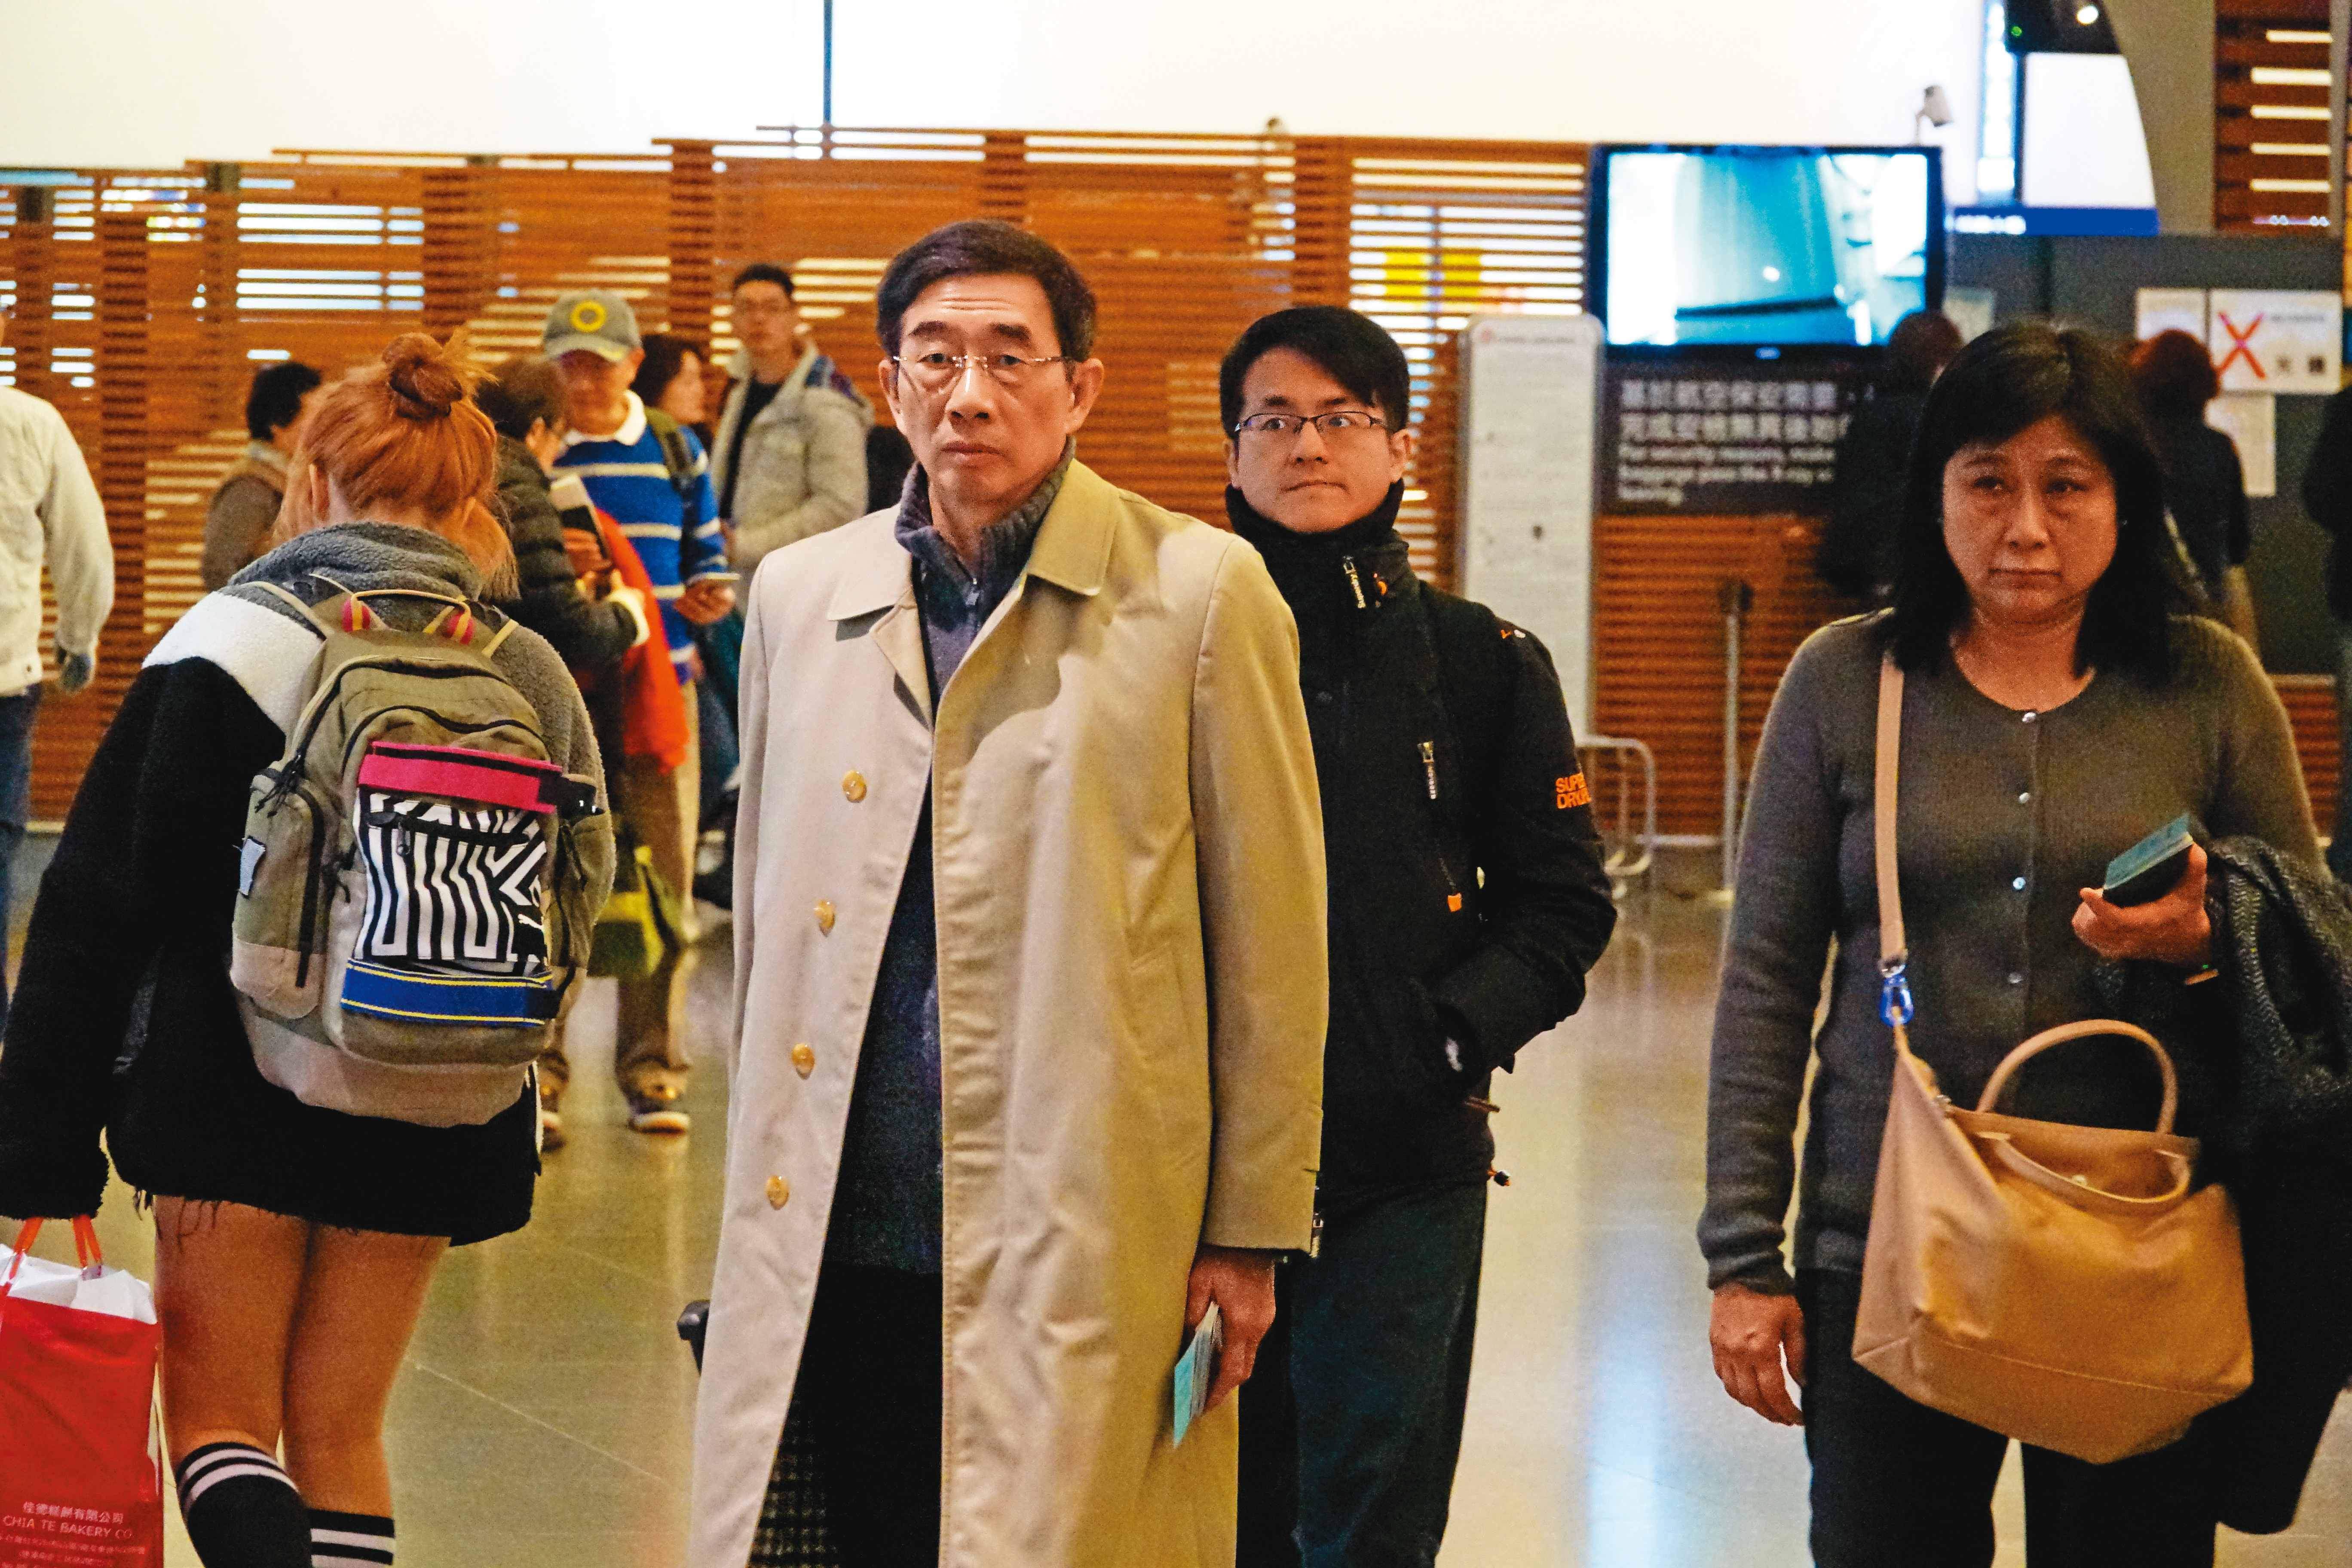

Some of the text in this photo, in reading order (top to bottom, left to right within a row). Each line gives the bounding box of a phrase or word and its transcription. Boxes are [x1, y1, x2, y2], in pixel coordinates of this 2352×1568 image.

[3, 1515, 35, 1529] CHIA
[41, 1519, 56, 1531] TE
[60, 1522, 111, 1538] BAKERY
